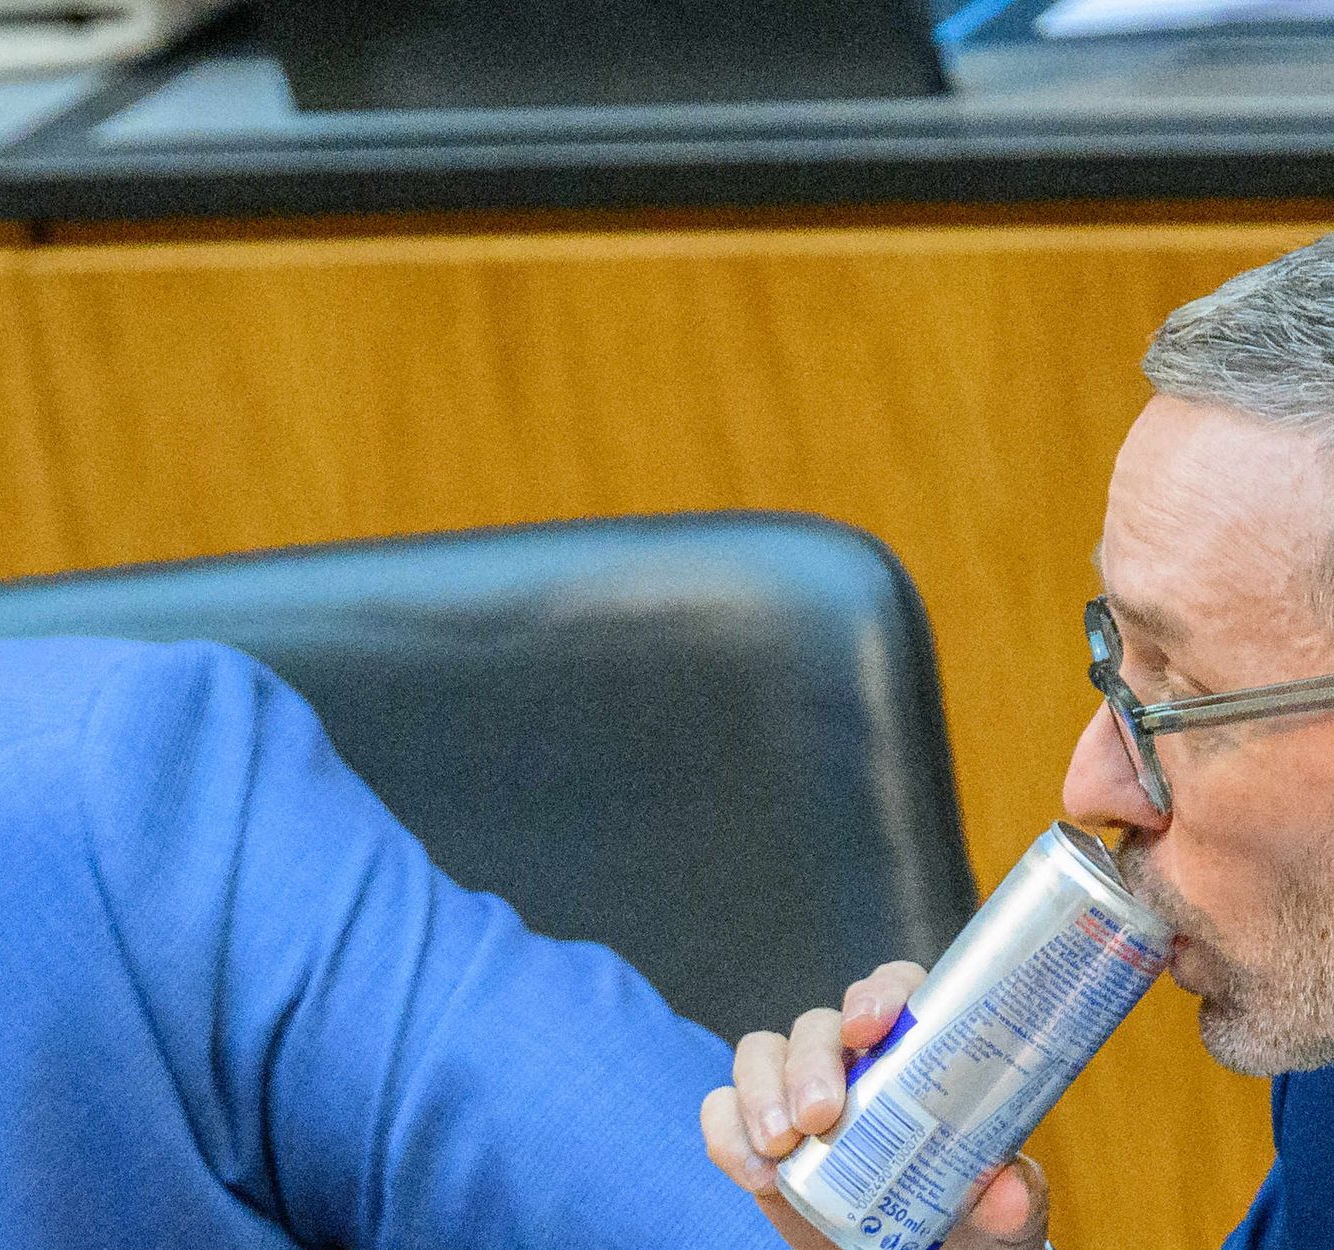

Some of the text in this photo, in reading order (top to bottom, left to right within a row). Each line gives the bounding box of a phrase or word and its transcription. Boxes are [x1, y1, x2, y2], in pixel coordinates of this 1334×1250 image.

[844, 1127, 927, 1224] 9 002490 100070
[876, 1194, 910, 1224] 250
[902, 1210, 926, 1234] ml
